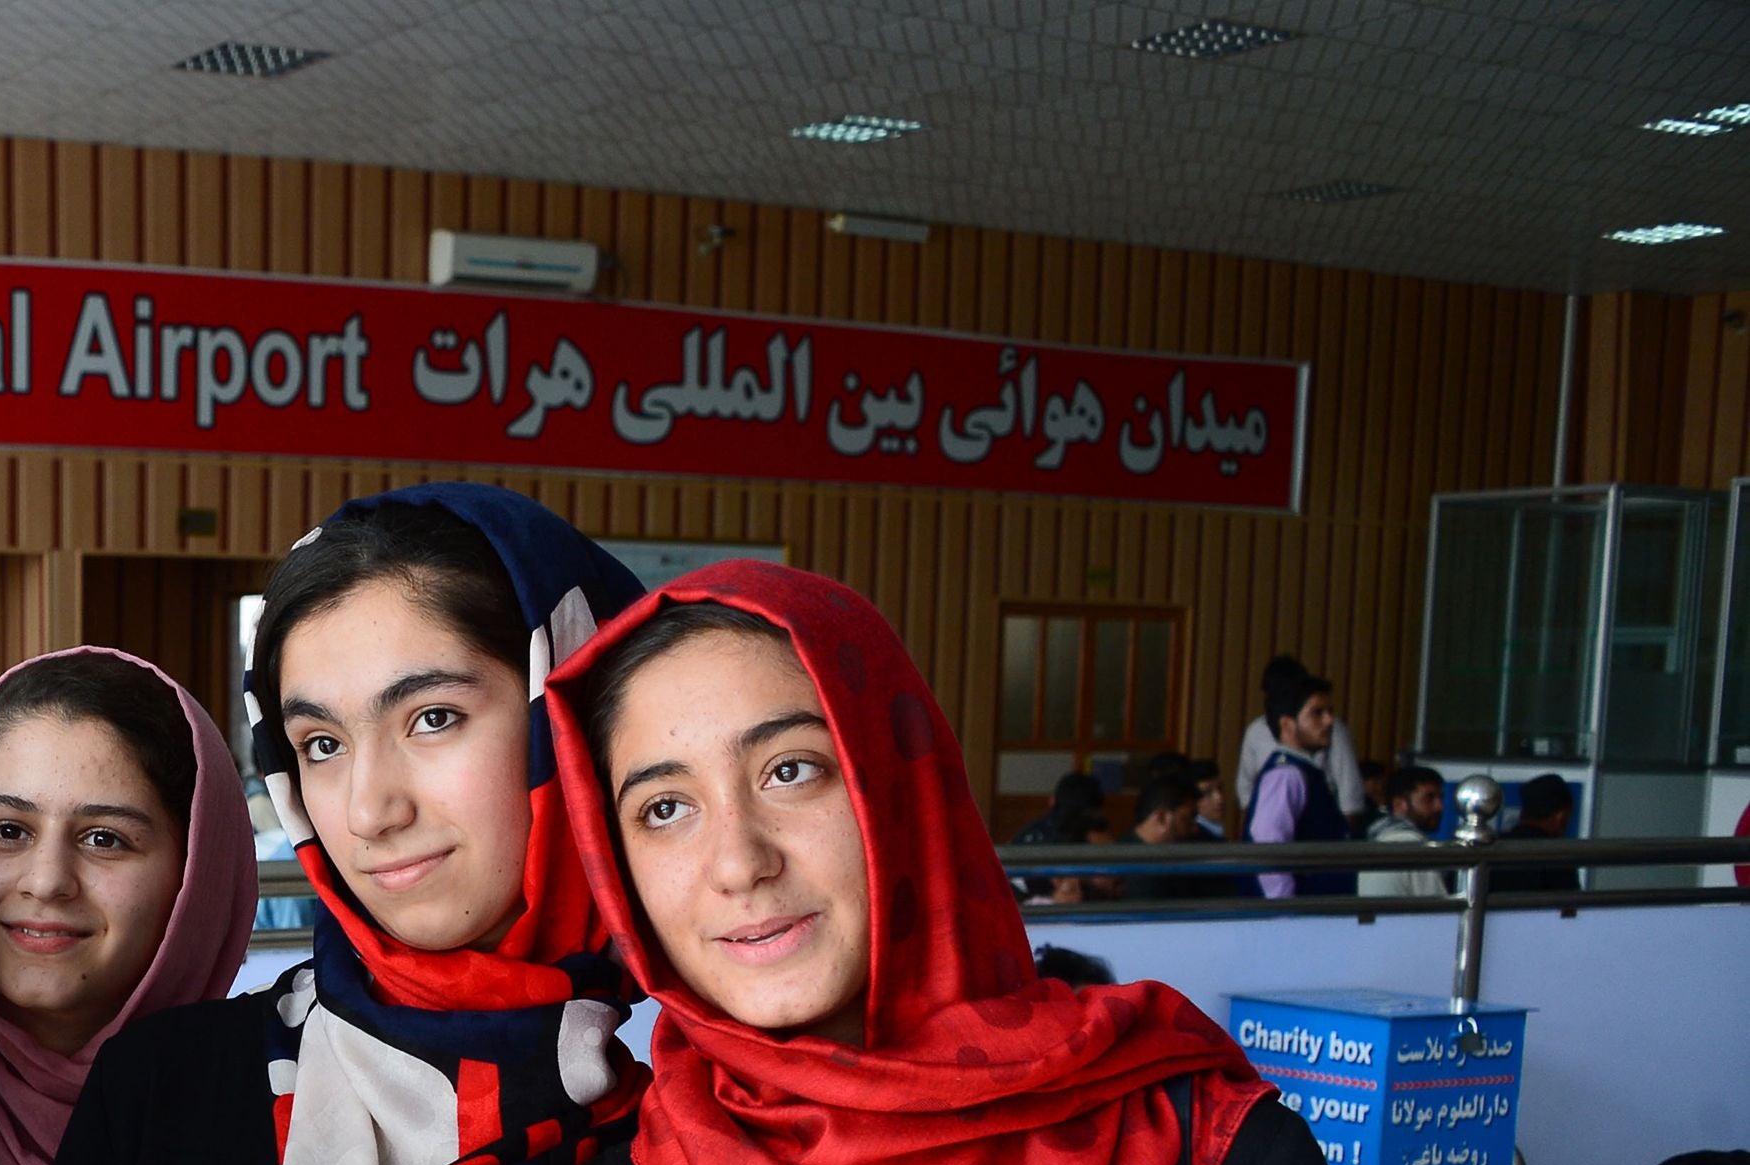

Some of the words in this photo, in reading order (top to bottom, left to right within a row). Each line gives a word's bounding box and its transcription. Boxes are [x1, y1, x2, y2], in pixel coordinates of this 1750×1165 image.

[59, 295, 369, 428] Airport
[412, 310, 595, 440] هرات
[611, 324, 813, 445] المللی
[826, 367, 923, 456] بین
[938, 345, 1104, 470] هوائی
[1119, 367, 1268, 475] میدان
[1238, 1018, 1322, 1064] Charity
[1328, 1030, 1373, 1066] box
[1309, 1094, 1371, 1124] your
[1391, 1098, 1433, 1132] مولانا
